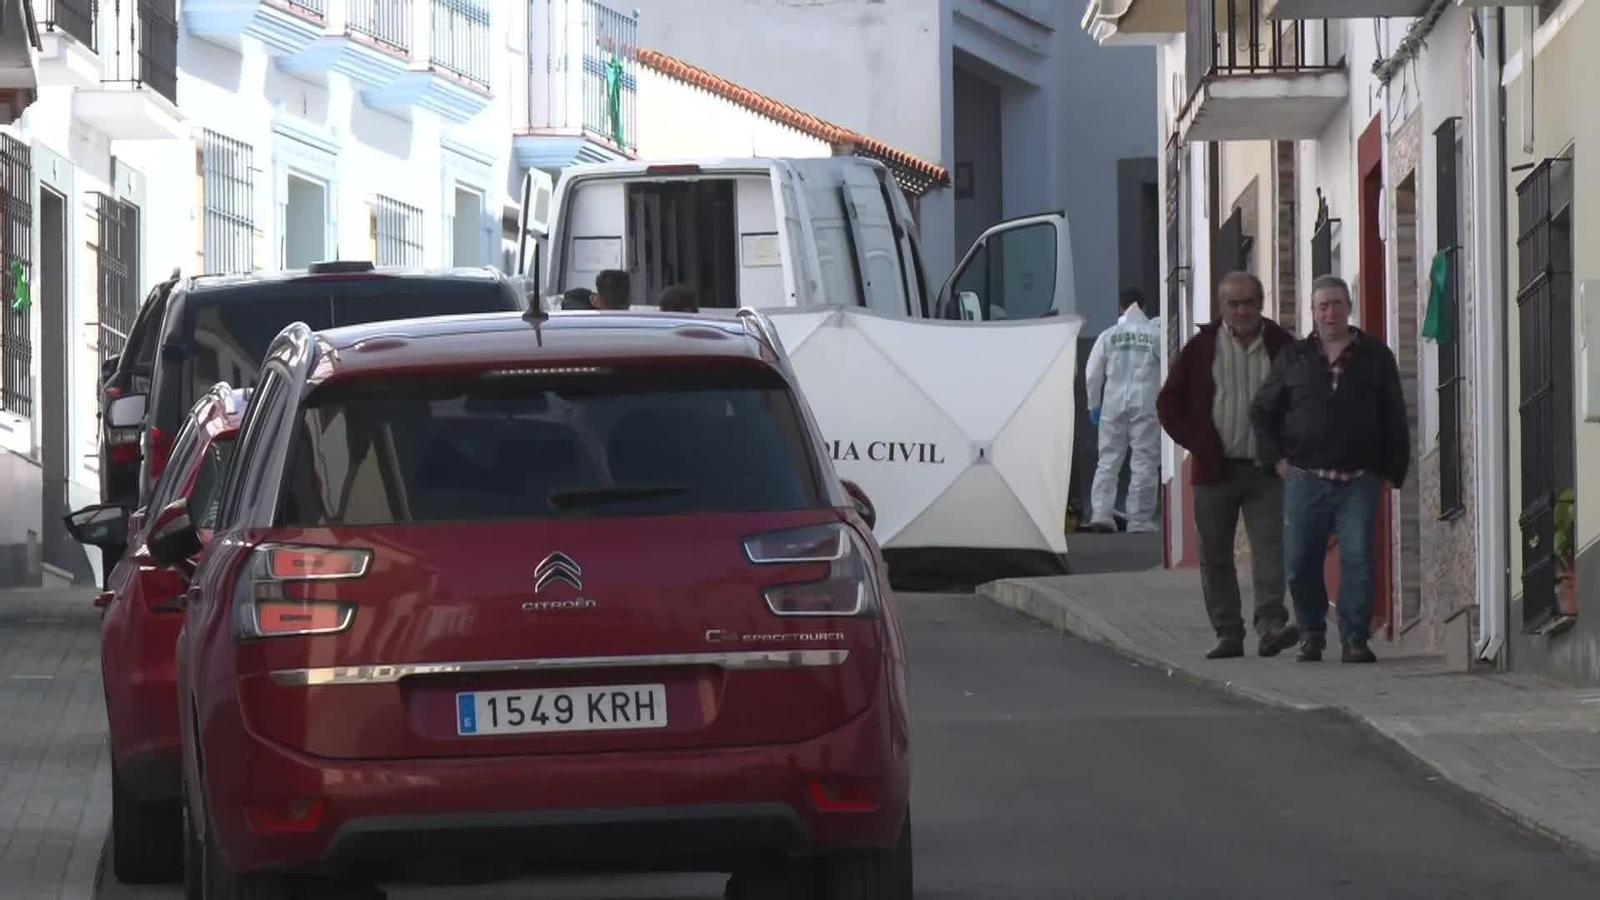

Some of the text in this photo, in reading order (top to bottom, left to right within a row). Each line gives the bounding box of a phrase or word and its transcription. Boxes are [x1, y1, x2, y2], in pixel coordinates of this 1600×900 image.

[867, 440, 945, 464] CIVIL
[487, 694, 574, 728] 1549
[587, 690, 655, 723] KRH
